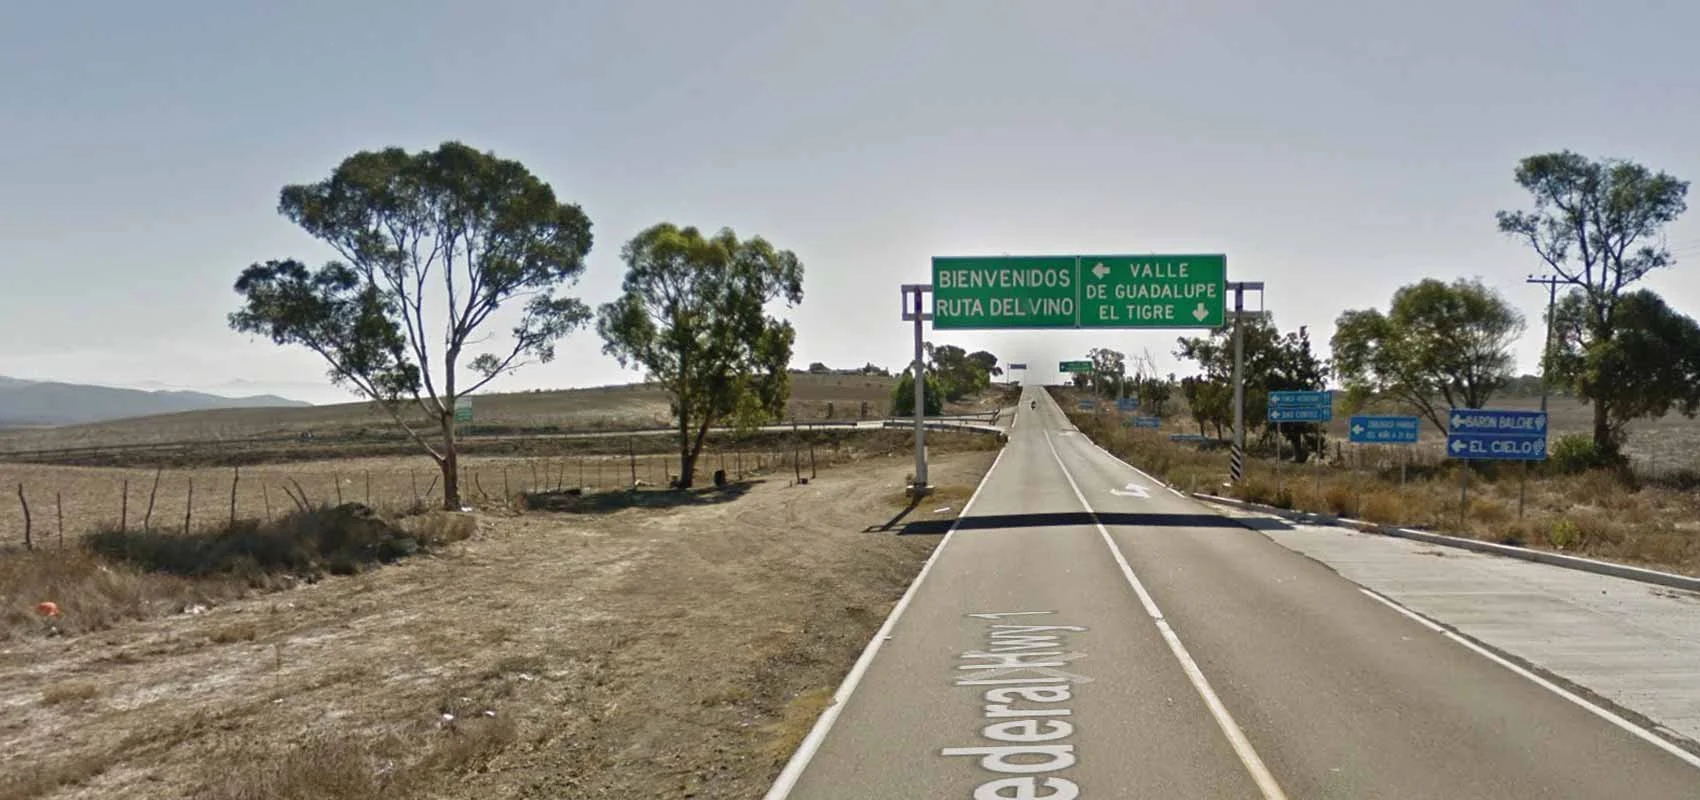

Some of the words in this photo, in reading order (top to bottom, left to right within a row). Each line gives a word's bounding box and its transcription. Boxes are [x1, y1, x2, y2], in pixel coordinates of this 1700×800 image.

[1130, 263, 1189, 278] VALLE
[939, 269, 1071, 288] BIENVENIDOS
[1086, 284, 1108, 299] DE
[1115, 283, 1217, 298] GUADALUPE
[936, 299, 984, 317] RUTA
[989, 298, 1026, 316] DEL
[1028, 298, 1074, 316] VINO
[1099, 305, 1119, 320] EL
[1126, 305, 1175, 320] TIGRE
[1470, 440, 1488, 453] EL
[1491, 440, 1532, 454] CIELO
